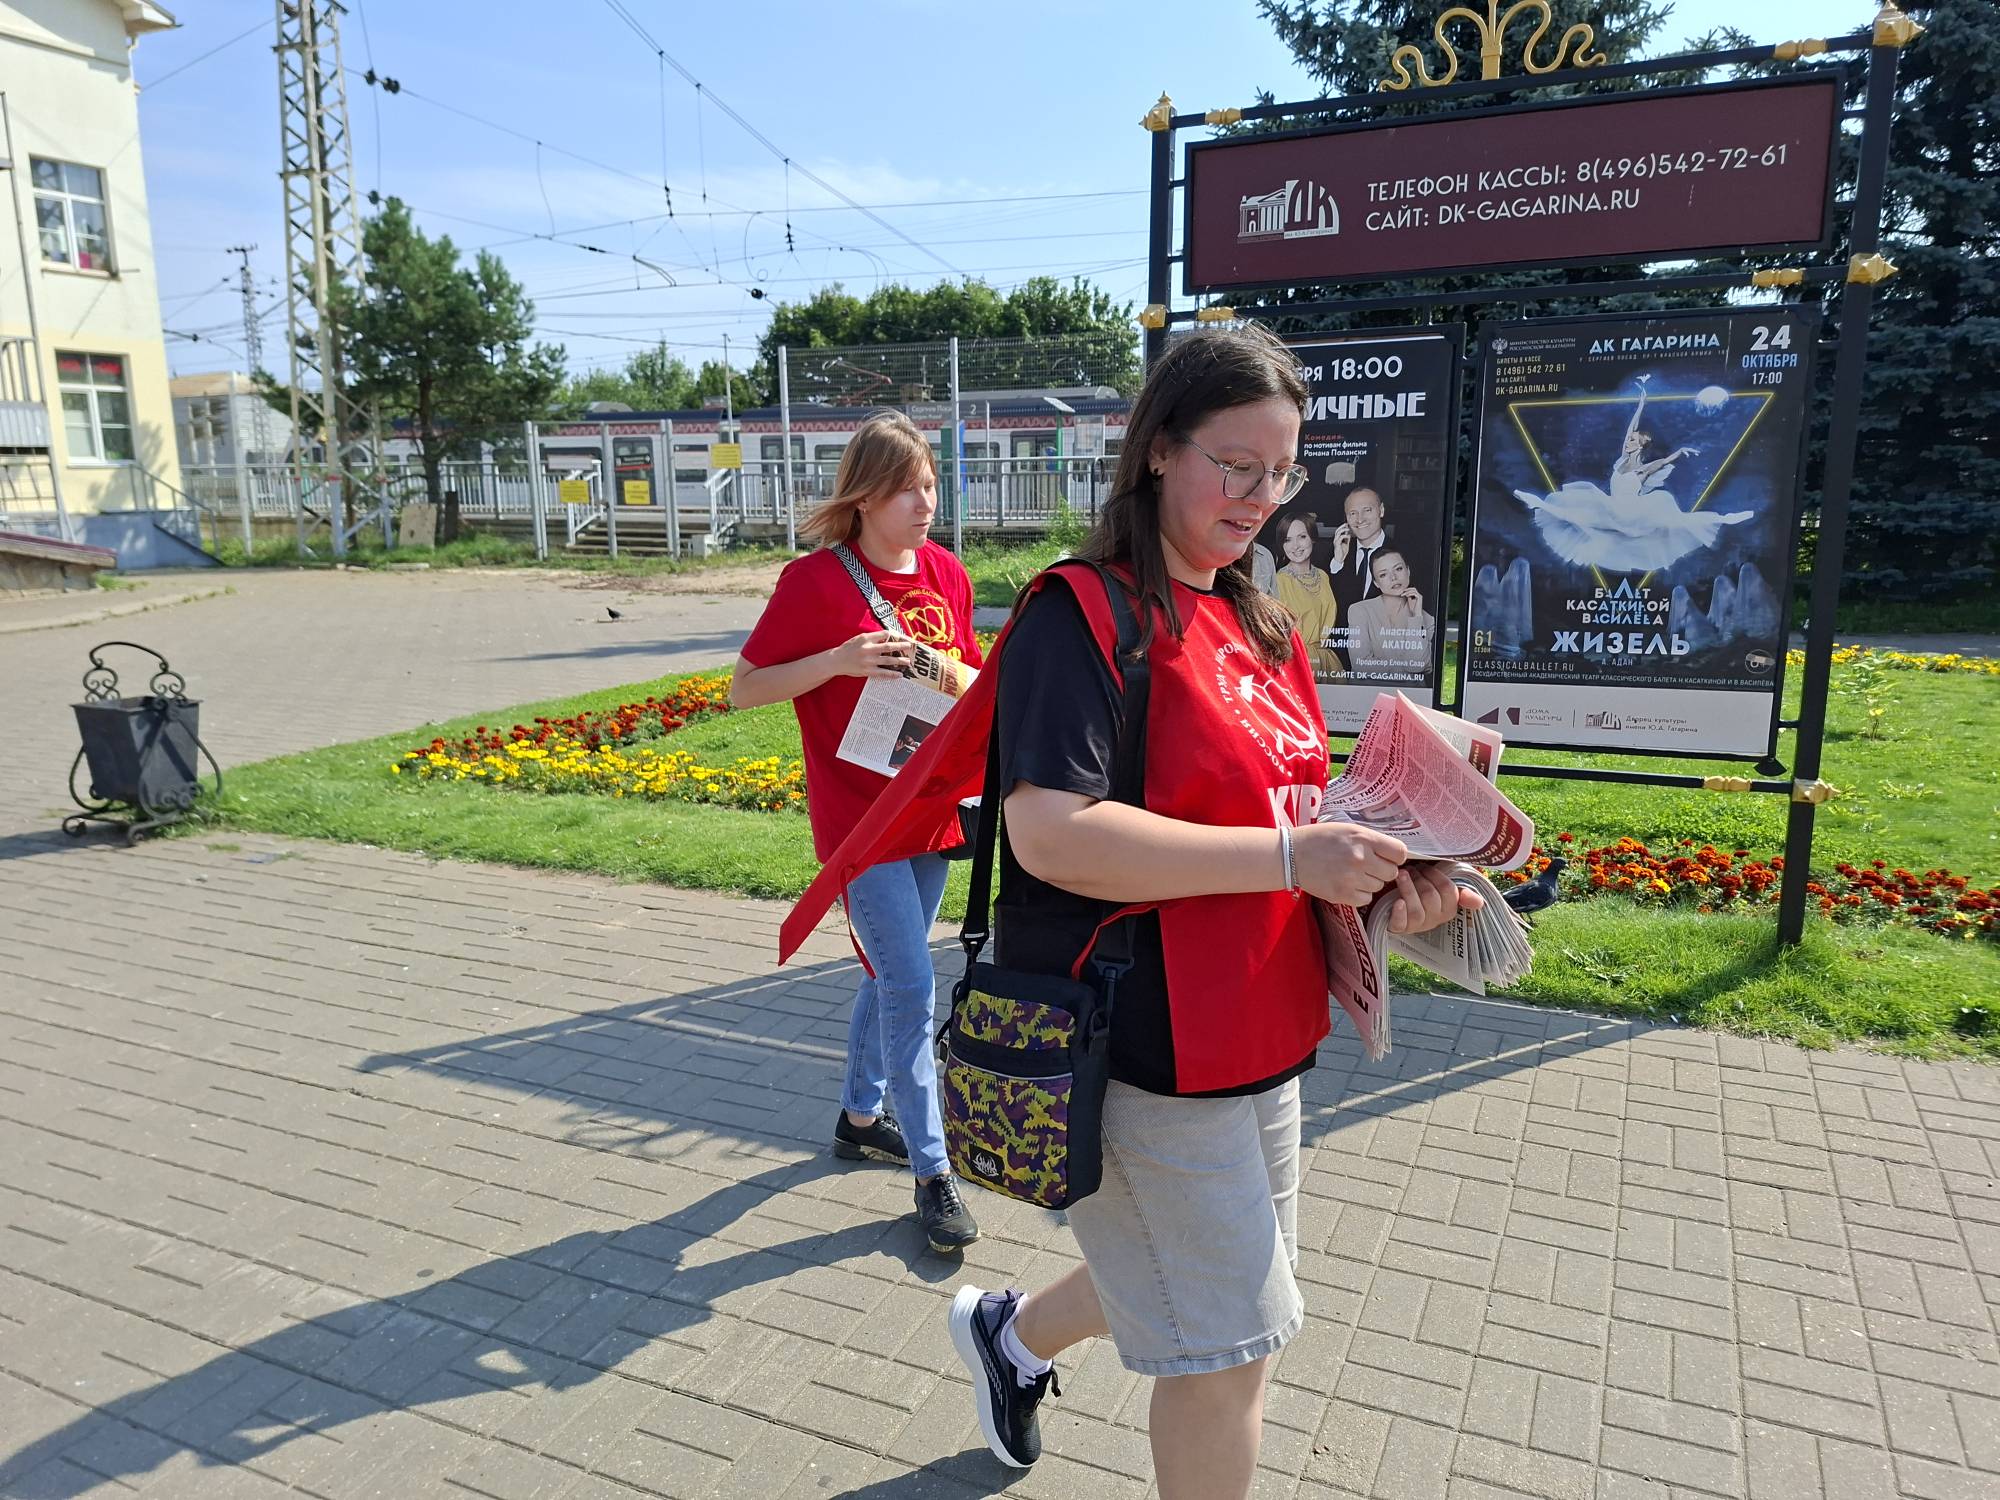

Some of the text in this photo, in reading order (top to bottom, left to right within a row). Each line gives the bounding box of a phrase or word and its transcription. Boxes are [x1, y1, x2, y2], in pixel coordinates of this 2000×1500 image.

[1367, 143, 1787, 202] ТЕЛЕФОН КАССЫ: 8(496)542-72-61
[1365, 188, 1640, 232] САЙТ: DK-GAGARINA.RU
[1589, 333, 1721, 354] ДК ГАГАРИНА
[1750, 324, 1791, 351] 24
[1298, 355, 1403, 382] БРЯ 18:00
[1742, 353, 1798, 368] ОКТЯБРЯ
[1503, 366, 1525, 375] (496)
[1527, 365, 1542, 374] 542
[1544, 364, 1554, 373] 72
[1556, 363, 1566, 372] 61
[1752, 371, 1783, 384] 17:00
[1495, 384, 1559, 395] DK-GAGARINA.RU
[970, 404, 977, 415] 2
[1304, 392, 1427, 421] ИЧНЫЕ
[1303, 448, 1367, 457] Романа Полански
[1341, 440, 1368, 450] фильма
[1594, 577, 1651, 599] БАЛЕТ
[1566, 597, 1670, 613] КАСАТКИНОЙ
[1321, 624, 1427, 637] Дмитрий Анастасия
[1474, 630, 1493, 647] 61
[1320, 638, 1424, 650] УЛЬЯНОВ АКАТОВА
[1550, 631, 1691, 656] ЖИЗЕЛЬ
[1472, 660, 1575, 671] CLASSICALBALLET.RU
[1611, 658, 1633, 666] АДАН
[1329, 669, 1355, 679] САЙТЕ
[1356, 671, 1425, 681] DK-GAGARINA.RU
[1472, 670, 1528, 678] ГОСУДАРСТВЕННЫЙ
[1600, 674, 1652, 683] КЛАССИЧЕСКОГО
[1653, 676, 1677, 684] БАЛЕТА
[1359, 708, 1378, 742] СРОКУ
[1360, 744, 1396, 799] ТЮРЕМНОМУ
[1391, 708, 1399, 744] СРОКУ
[1491, 835, 1516, 864] Думы
[1456, 918, 1464, 959] СРОКУ
